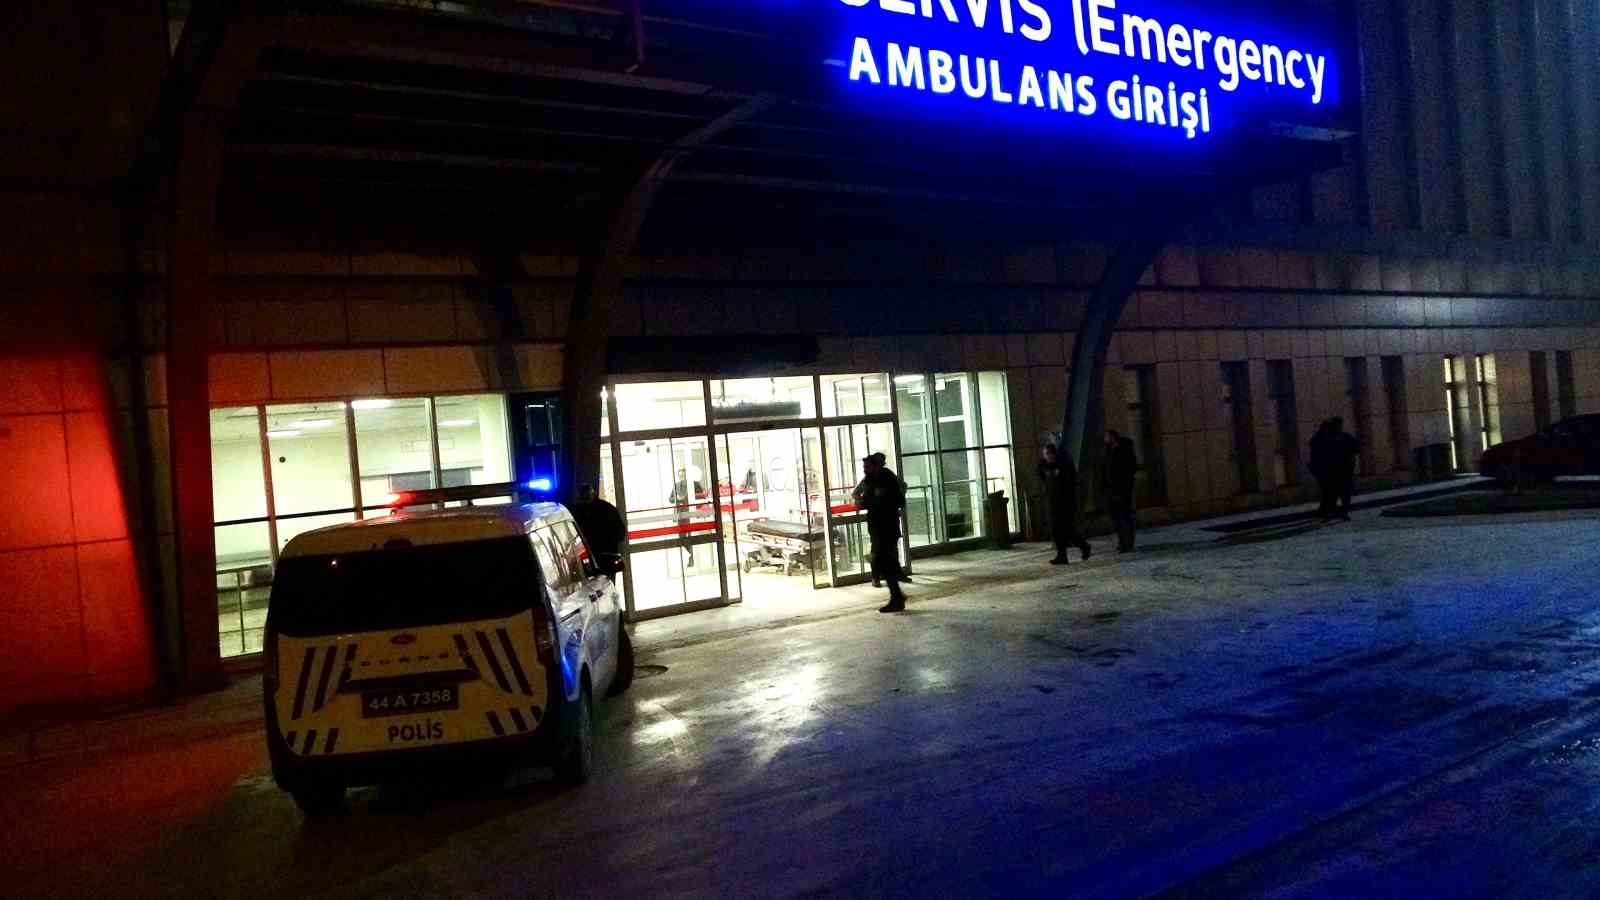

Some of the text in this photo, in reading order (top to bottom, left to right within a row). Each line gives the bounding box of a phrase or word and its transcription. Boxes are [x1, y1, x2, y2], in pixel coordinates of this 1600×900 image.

[840, 0, 1052, 42] VIS
[849, 36, 1211, 139] AMBULANS GİRİŞİ
[369, 690, 452, 710] 44 A 7358
[388, 719, 443, 742] POLİS
